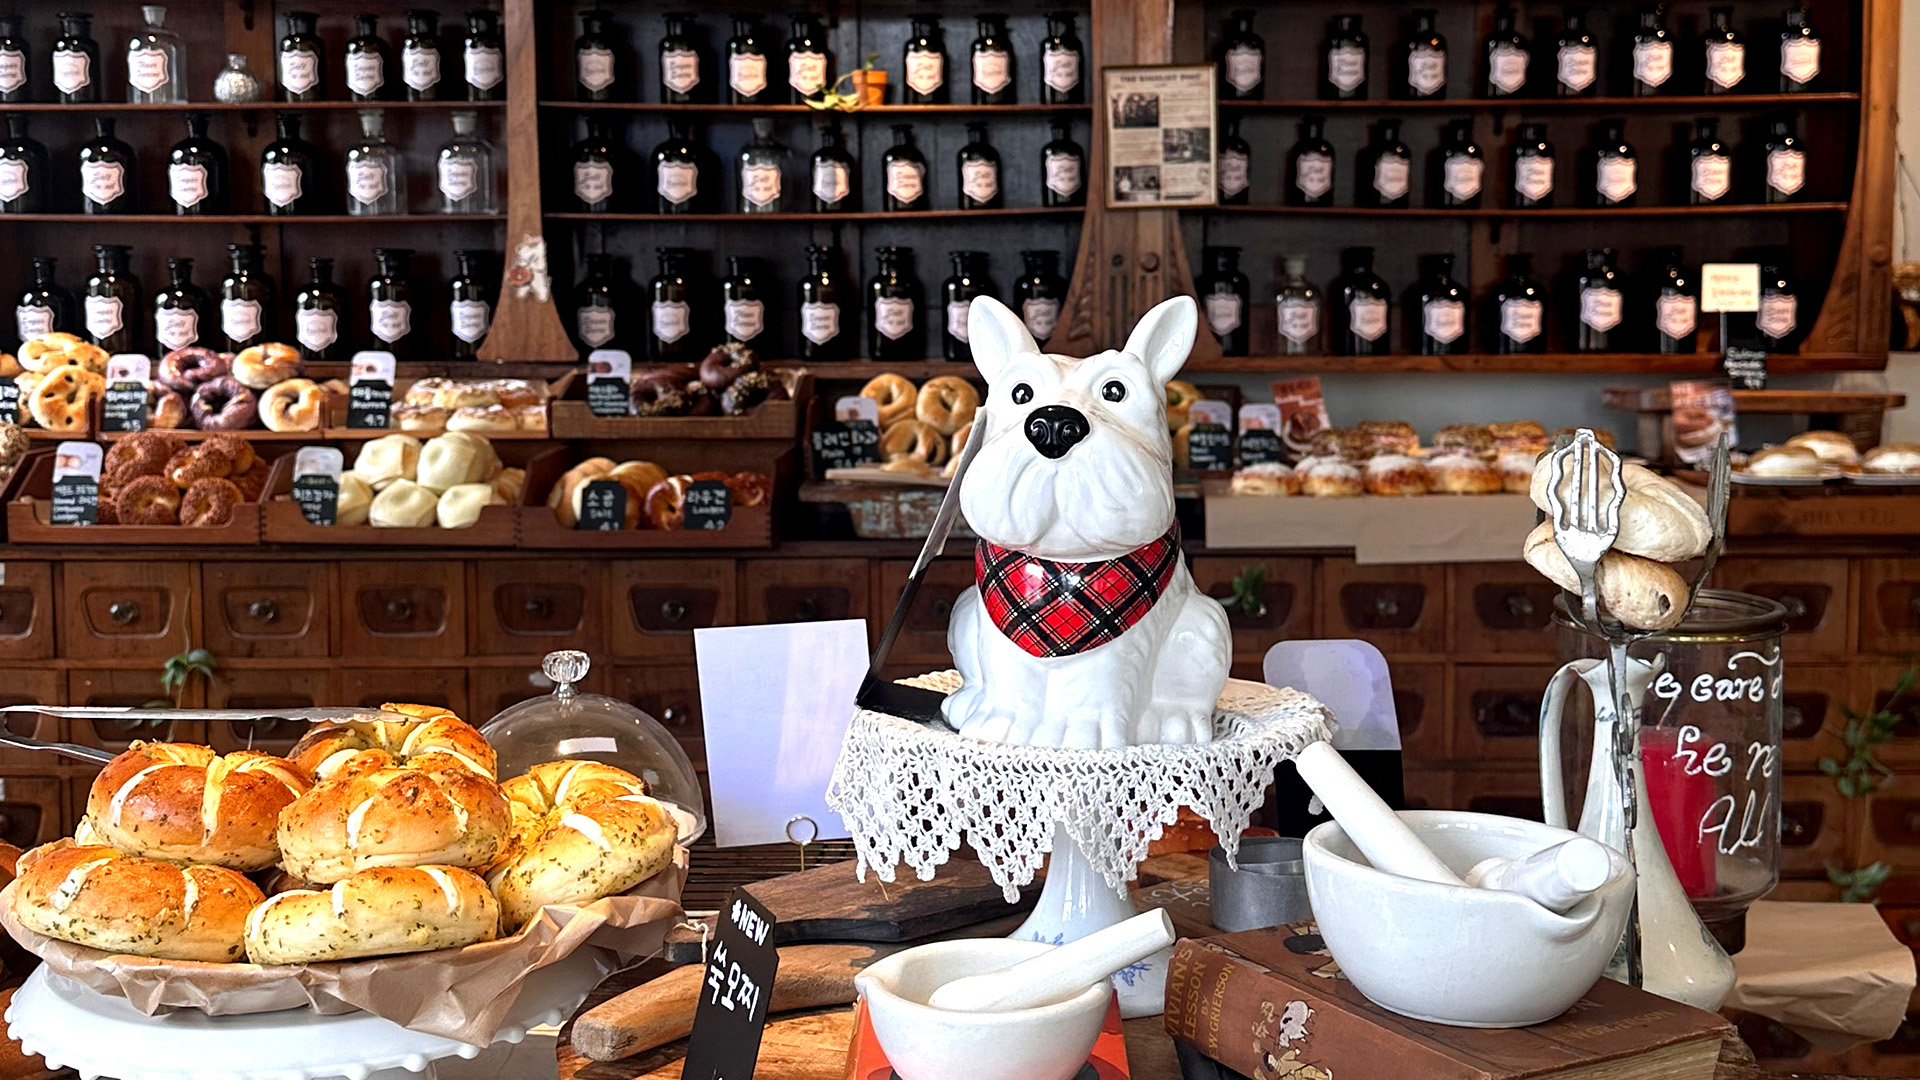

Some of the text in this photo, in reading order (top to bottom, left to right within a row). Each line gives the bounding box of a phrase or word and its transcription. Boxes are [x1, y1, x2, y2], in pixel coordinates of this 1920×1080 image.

[587, 489, 615, 508] 소금
[1183, 961, 1207, 1041] LESSON
[1201, 995, 1210, 1016] BY
[1209, 963, 1236, 1032] GRIERSON
